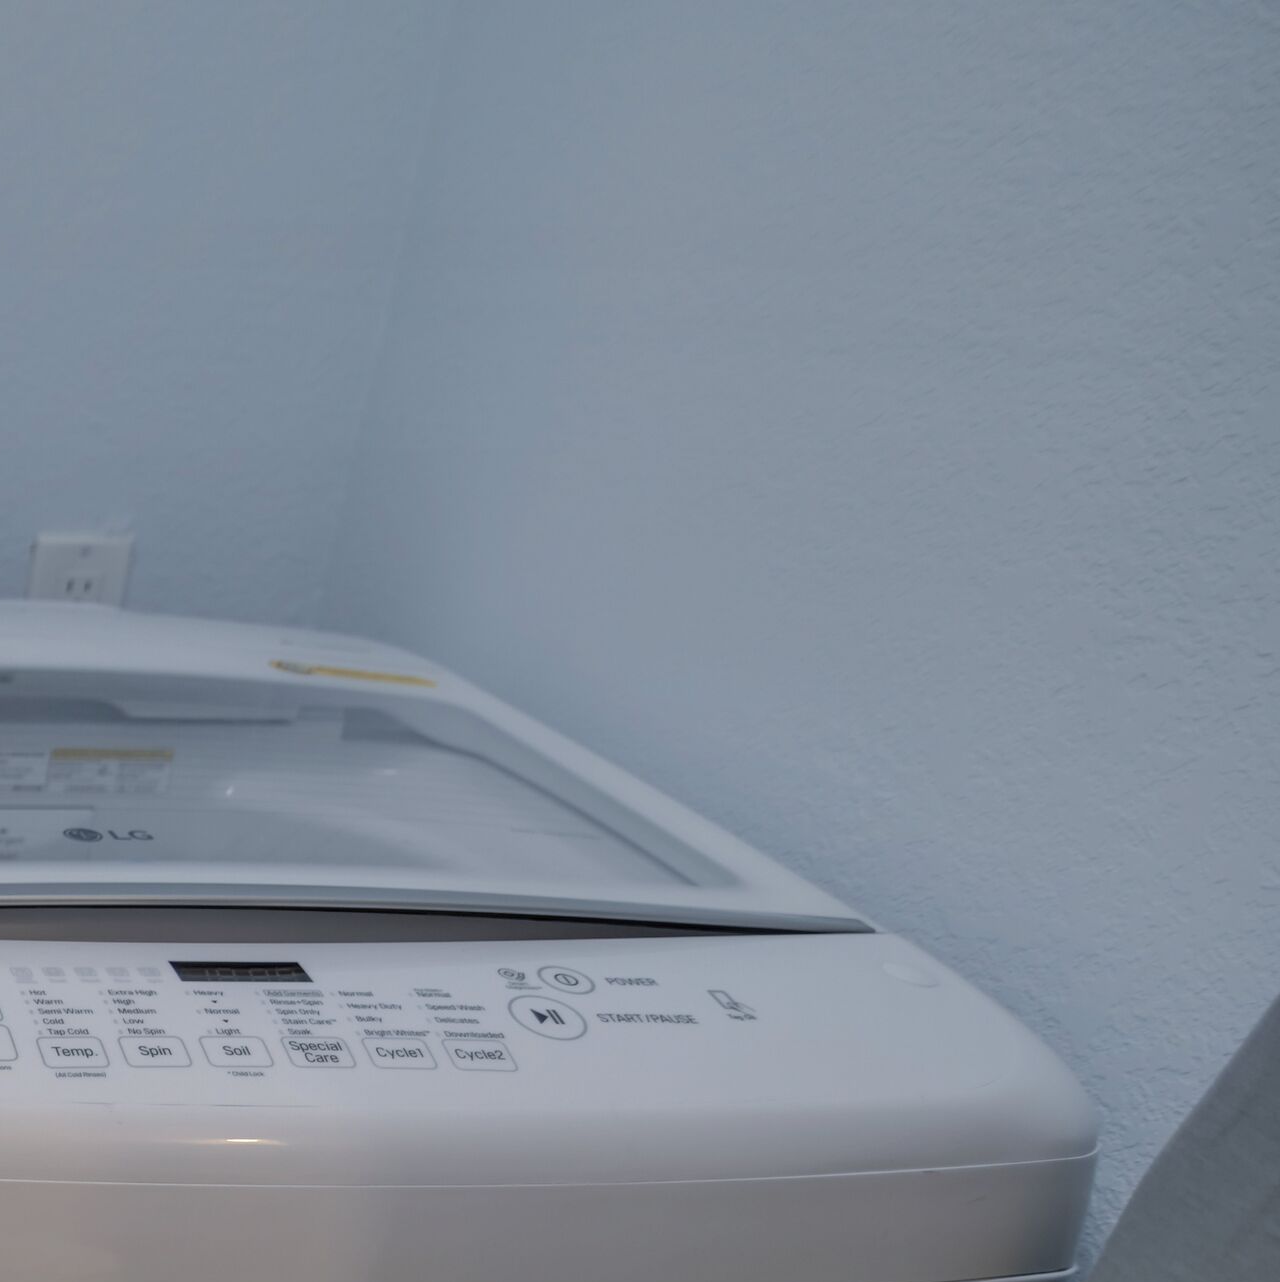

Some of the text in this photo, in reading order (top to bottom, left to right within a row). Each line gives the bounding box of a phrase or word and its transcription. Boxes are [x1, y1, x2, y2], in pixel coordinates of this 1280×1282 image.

[604, 977, 658, 986] POWER
[135, 989, 157, 997] High
[299, 1008, 320, 1016] Only
[378, 1003, 402, 1011] Duty
[425, 1004, 456, 1012] Speed
[596, 1013, 699, 1024] START/PAUSE
[47, 1028, 67, 1036] Tap
[364, 1029, 392, 1037] Bright
[444, 1031, 505, 1039] Downloaded
[51, 1046, 98, 1058] Temp.
[138, 1045, 172, 1058] Spin
[222, 1045, 251, 1056] Soil
[289, 1041, 343, 1053] Special
[305, 1052, 339, 1063] Care
[375, 1047, 424, 1059] Cycle1
[454, 1049, 506, 1061] Cycle2
